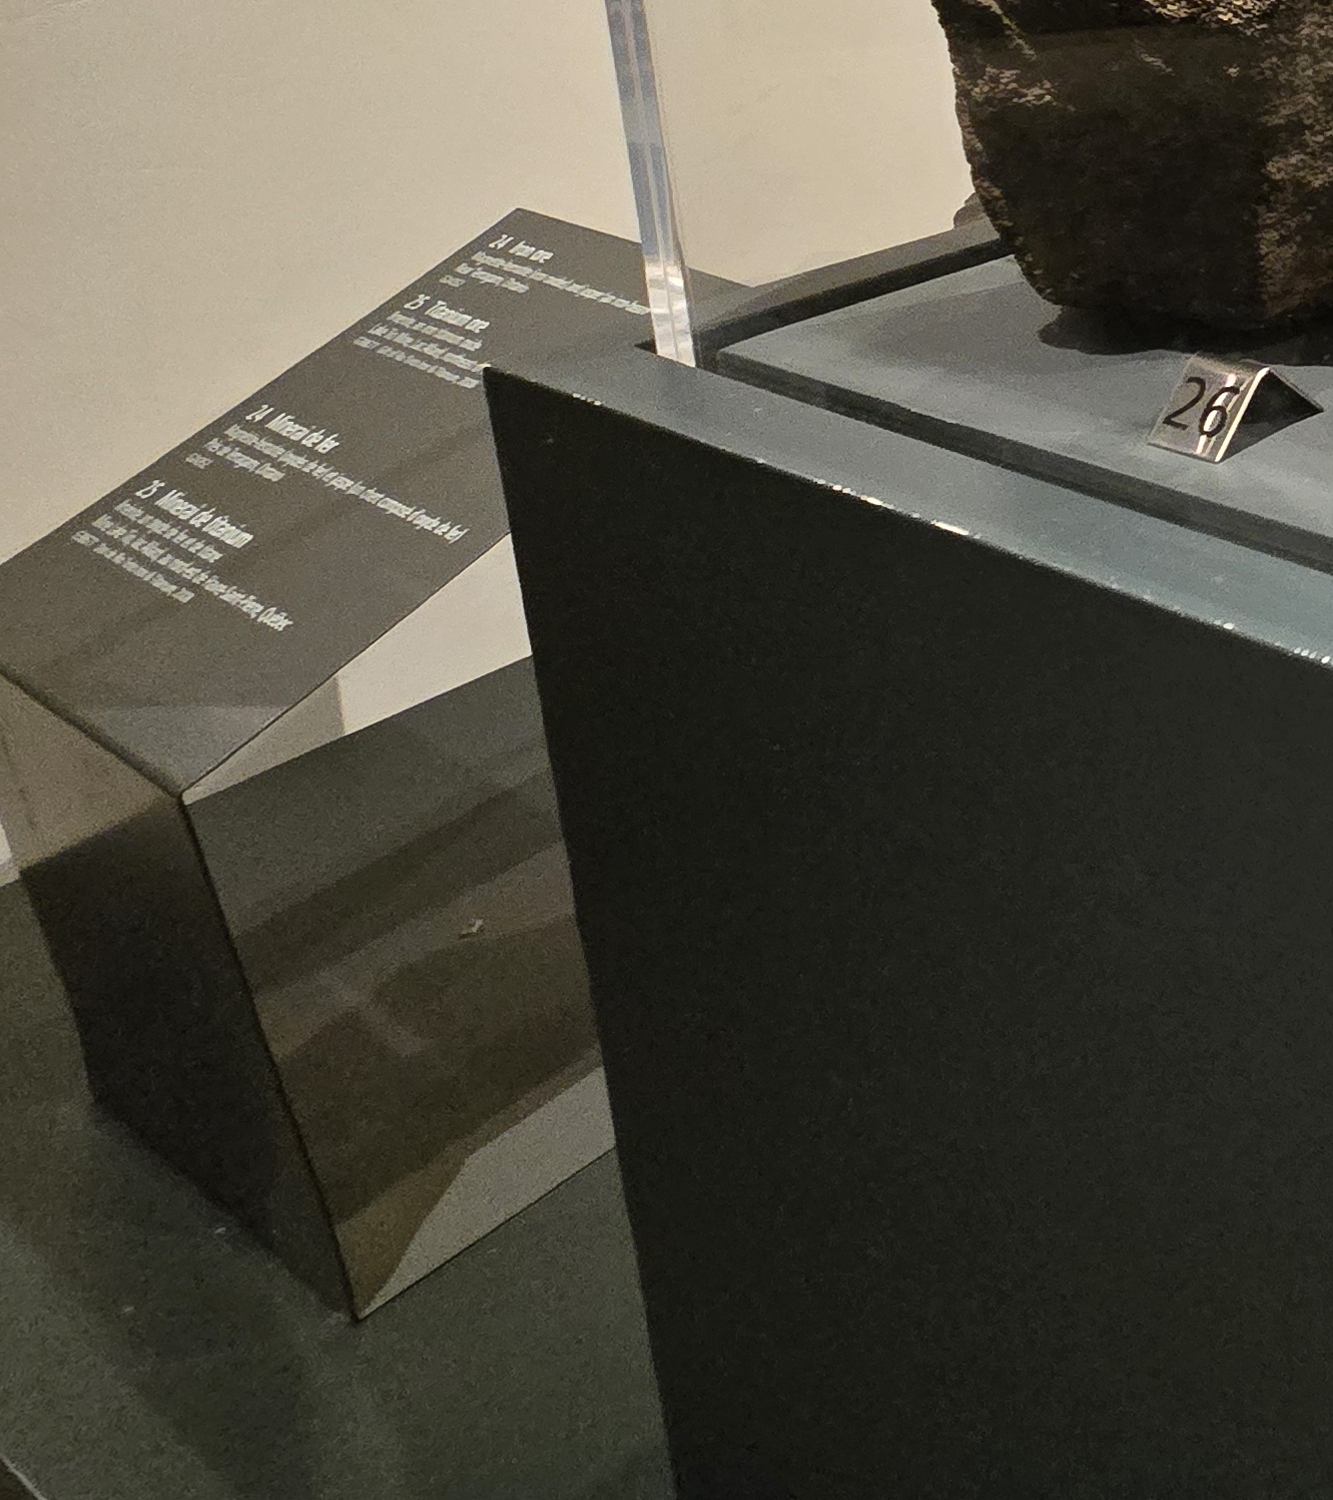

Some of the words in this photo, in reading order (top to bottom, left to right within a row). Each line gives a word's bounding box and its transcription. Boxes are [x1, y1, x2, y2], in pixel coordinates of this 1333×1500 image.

[245, 404, 274, 422] 24
[1162, 376, 1240, 438] 26
[135, 479, 166, 499] 25
